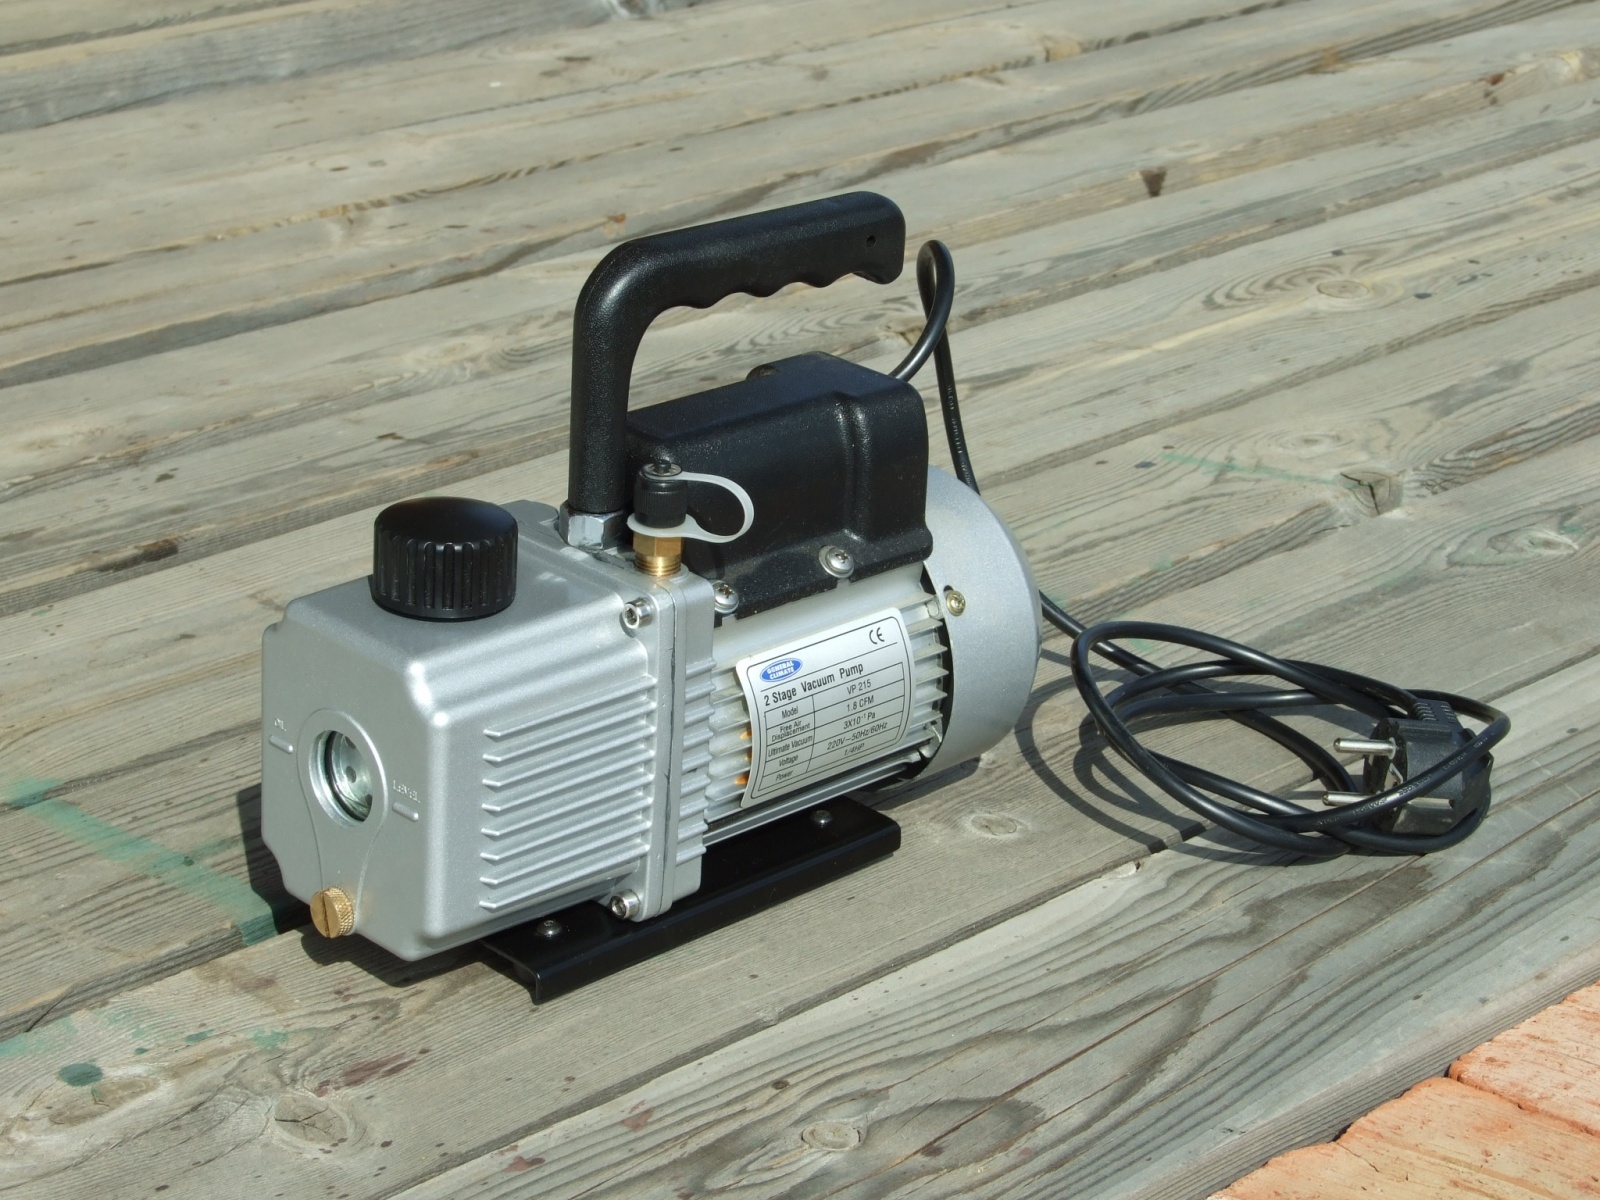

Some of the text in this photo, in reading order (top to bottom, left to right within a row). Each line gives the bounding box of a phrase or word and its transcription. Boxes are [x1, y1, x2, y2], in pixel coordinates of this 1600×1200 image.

[766, 660, 795, 675] GENERAL
[769, 667, 795, 680] CLIMATE
[763, 663, 864, 707] 2 Stage Vacuum Pump
[846, 678, 872, 695] VP 215
[846, 694, 875, 712] 1.8 CFM
[781, 705, 799, 719] Model
[867, 711, 876, 721] Pa
[771, 722, 811, 742] Displacement
[779, 720, 802, 734] Free Air
[767, 735, 813, 758] Ultimate Vacuum
[779, 754, 799, 767] Voltage
[775, 769, 794, 782] Power
[392, 779, 421, 803] LEVEL
